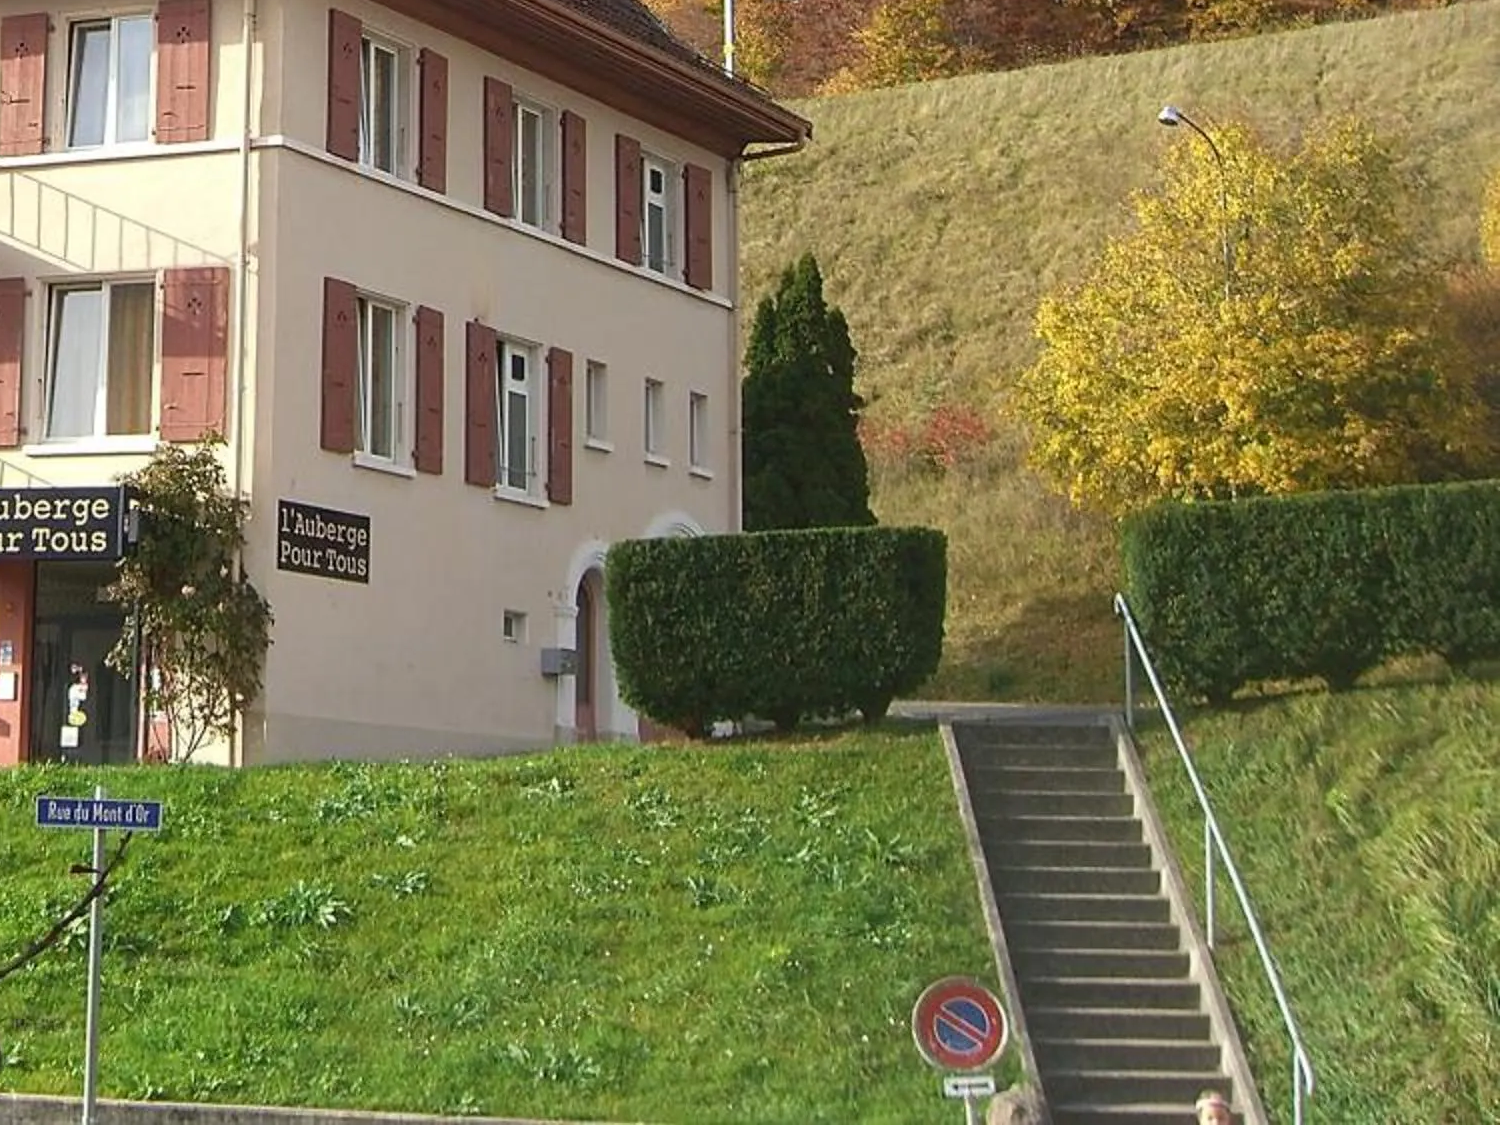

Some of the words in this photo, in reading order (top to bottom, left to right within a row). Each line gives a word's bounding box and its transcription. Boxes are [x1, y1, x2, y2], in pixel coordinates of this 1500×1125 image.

[31, 528, 107, 552] Tous
[281, 508, 367, 550] l'Auberge
[280, 540, 322, 568] Pour
[325, 548, 367, 576] Tous
[48, 801, 71, 820] Rue
[74, 802, 89, 820] du
[93, 803, 122, 822] Mont
[125, 803, 150, 823] d'Or
